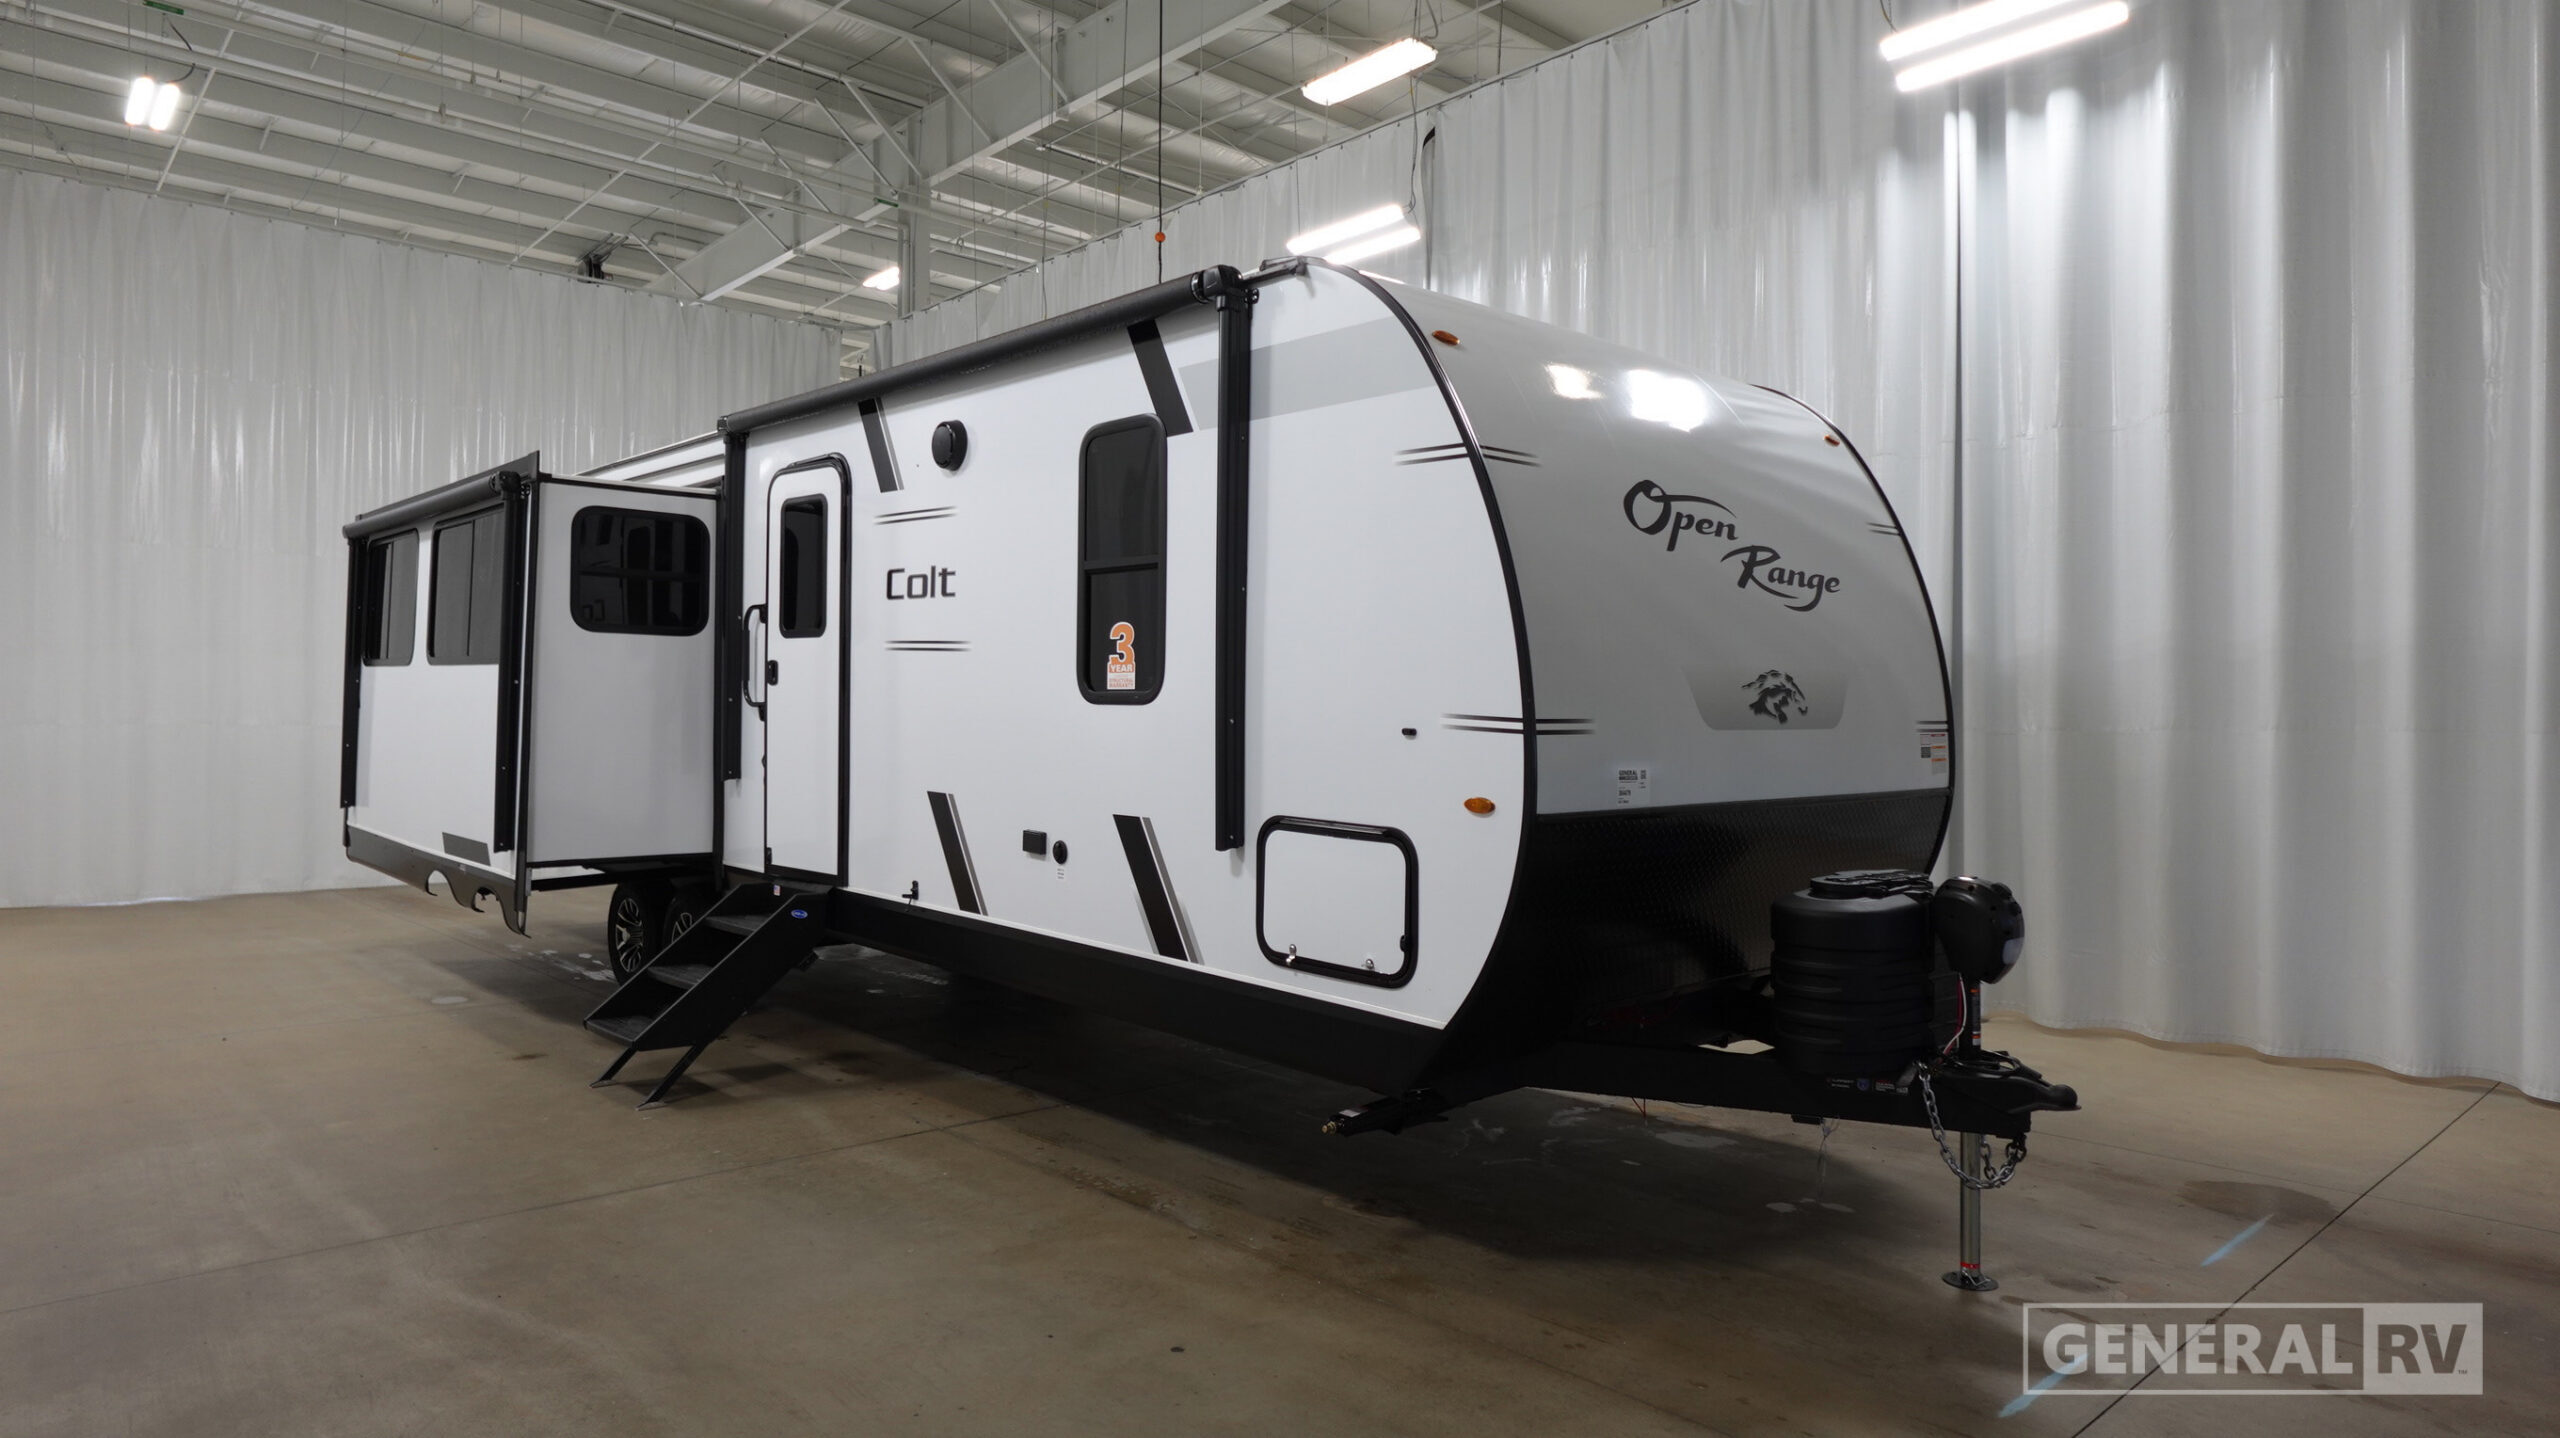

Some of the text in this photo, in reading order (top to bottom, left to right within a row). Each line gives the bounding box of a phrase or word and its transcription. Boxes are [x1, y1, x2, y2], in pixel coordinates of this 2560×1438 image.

[1623, 479, 1739, 552] Open
[886, 565, 957, 600] Colt
[1720, 545, 1841, 612] Range
[1109, 622, 1135, 664] 3
[1110, 664, 1133, 673] YEAR
